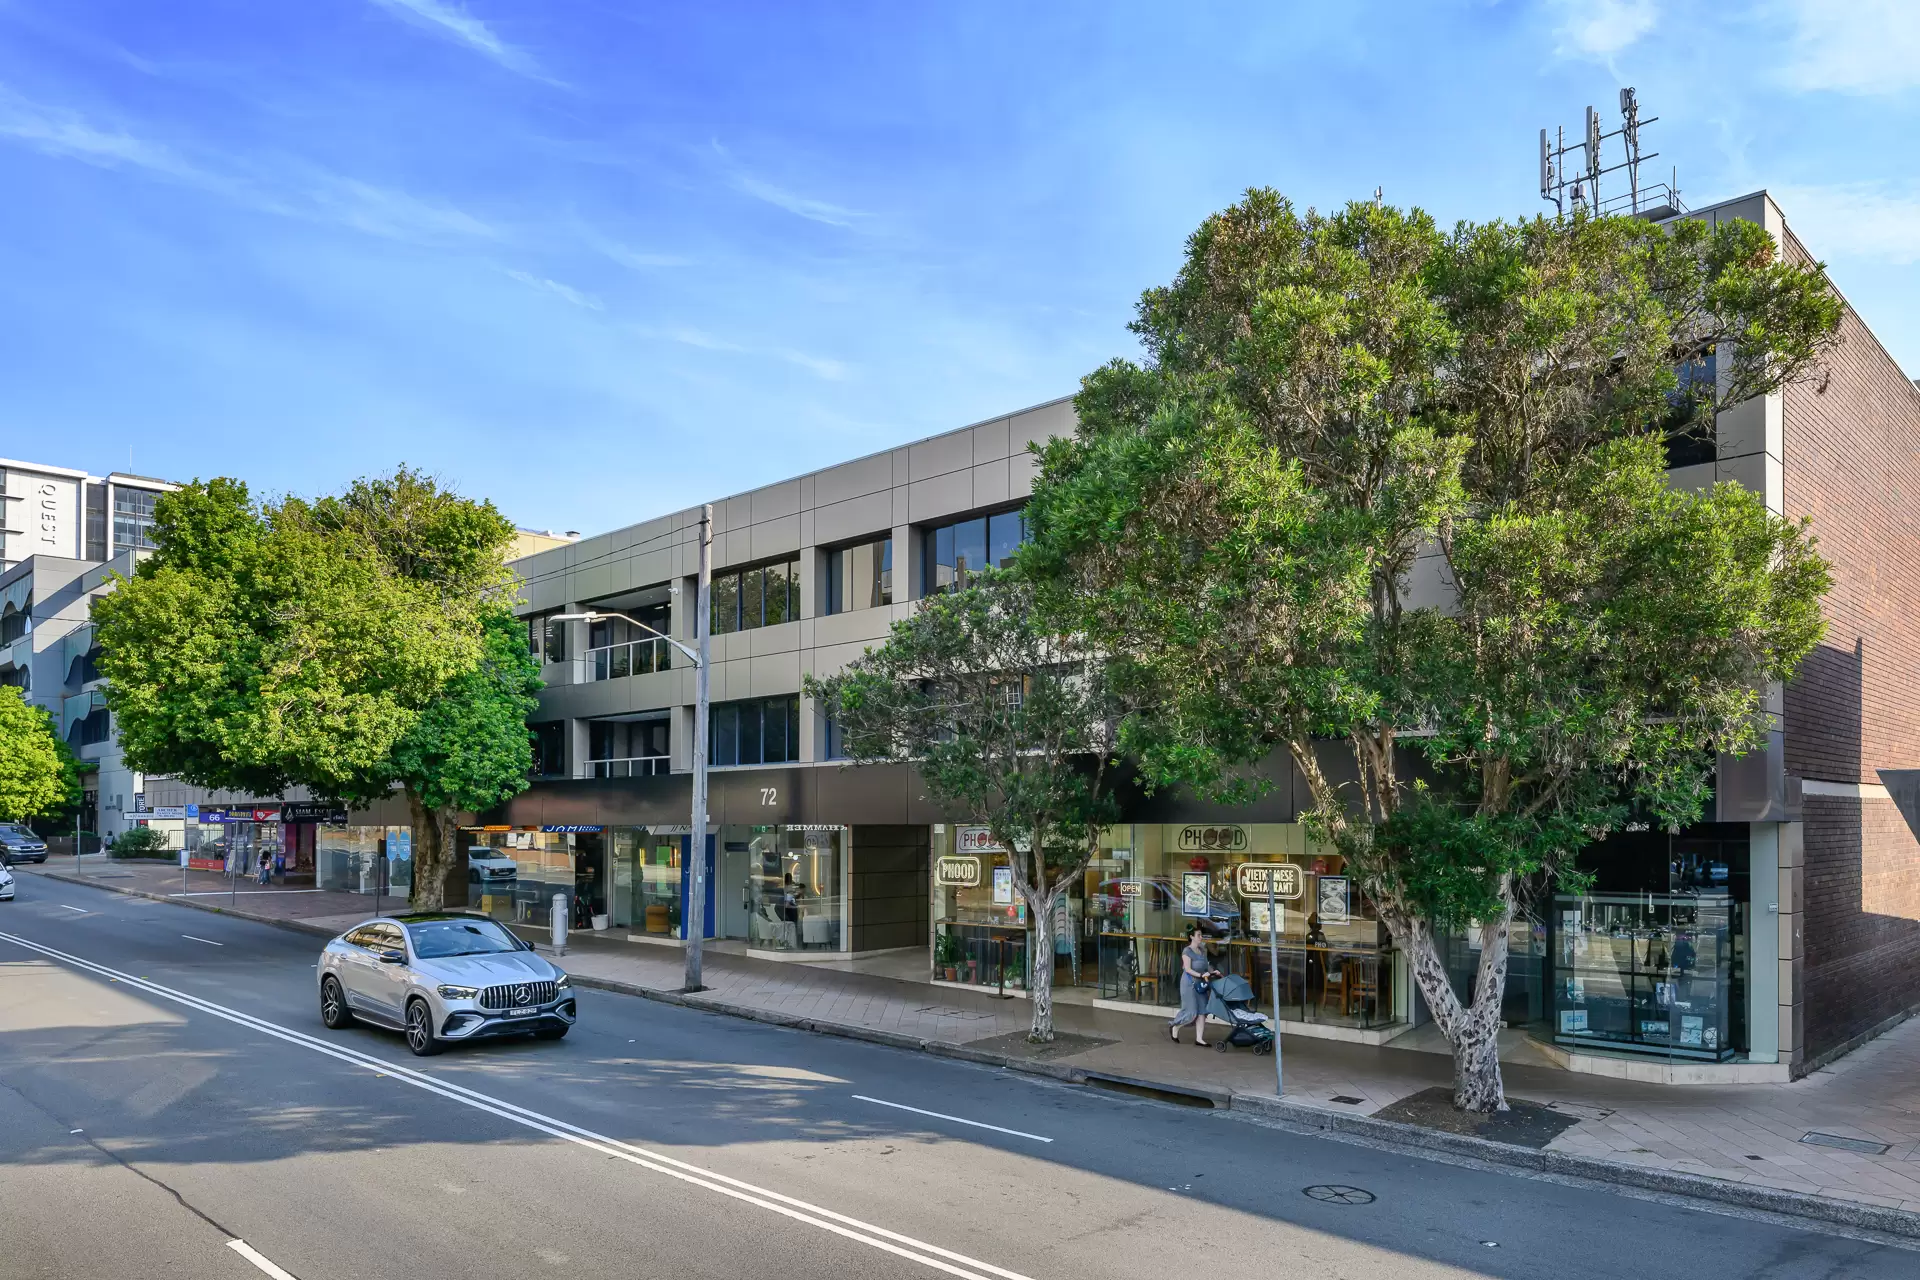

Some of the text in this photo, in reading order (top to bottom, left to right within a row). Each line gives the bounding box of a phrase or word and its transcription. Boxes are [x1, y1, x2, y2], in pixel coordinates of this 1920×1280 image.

[38, 484, 56, 545] QUEST
[760, 787, 777, 806] 72
[1184, 827, 1243, 846] PHOOD
[942, 862, 975, 880] PHOOD
[1245, 869, 1294, 881] VIETNMESE
[1122, 884, 1140, 893] OPEN
[1246, 881, 1294, 893] RESTARANT
